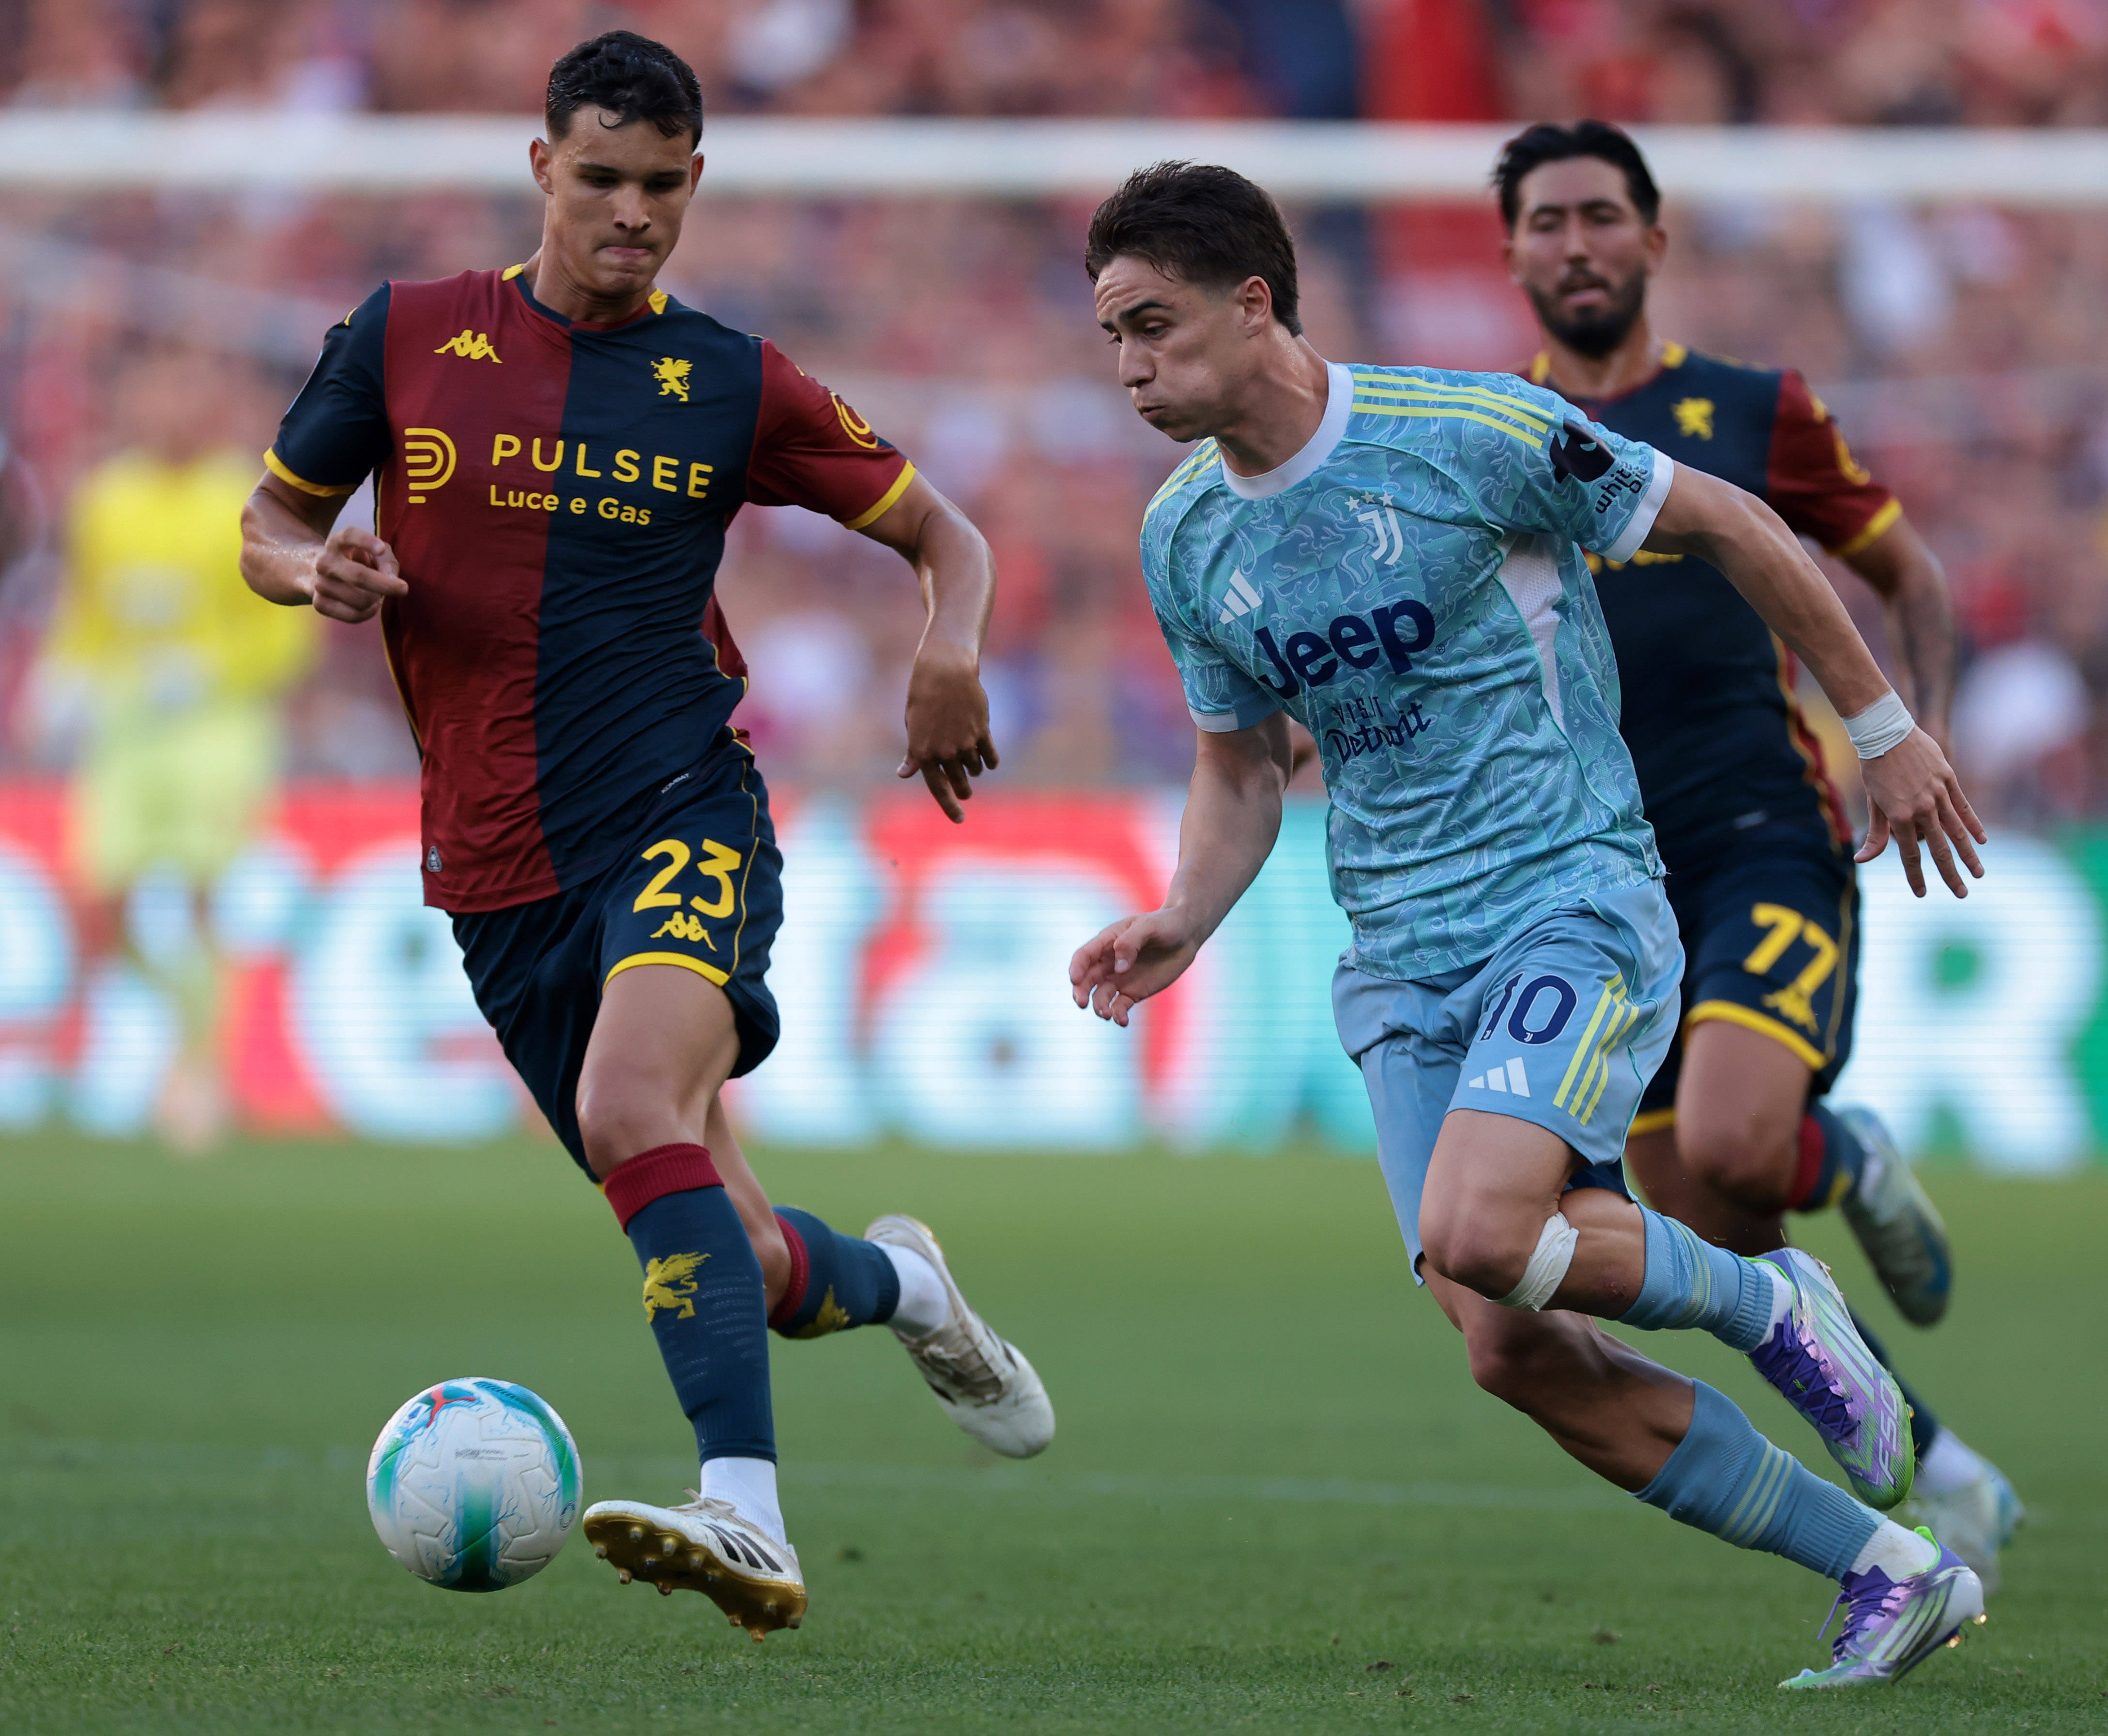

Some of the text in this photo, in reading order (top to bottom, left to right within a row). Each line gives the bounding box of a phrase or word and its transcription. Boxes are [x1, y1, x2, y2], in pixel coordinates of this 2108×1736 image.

[491, 433, 714, 499] PULSEE
[489, 484, 652, 526] Luce e Gas
[1254, 599, 1436, 700] Jeep
[1324, 702, 1432, 765] Detroit
[1331, 696, 1384, 725] VISIT
[632, 838, 742, 919] 23
[1743, 902, 1840, 996] 77
[1479, 971, 1579, 1046] 10
